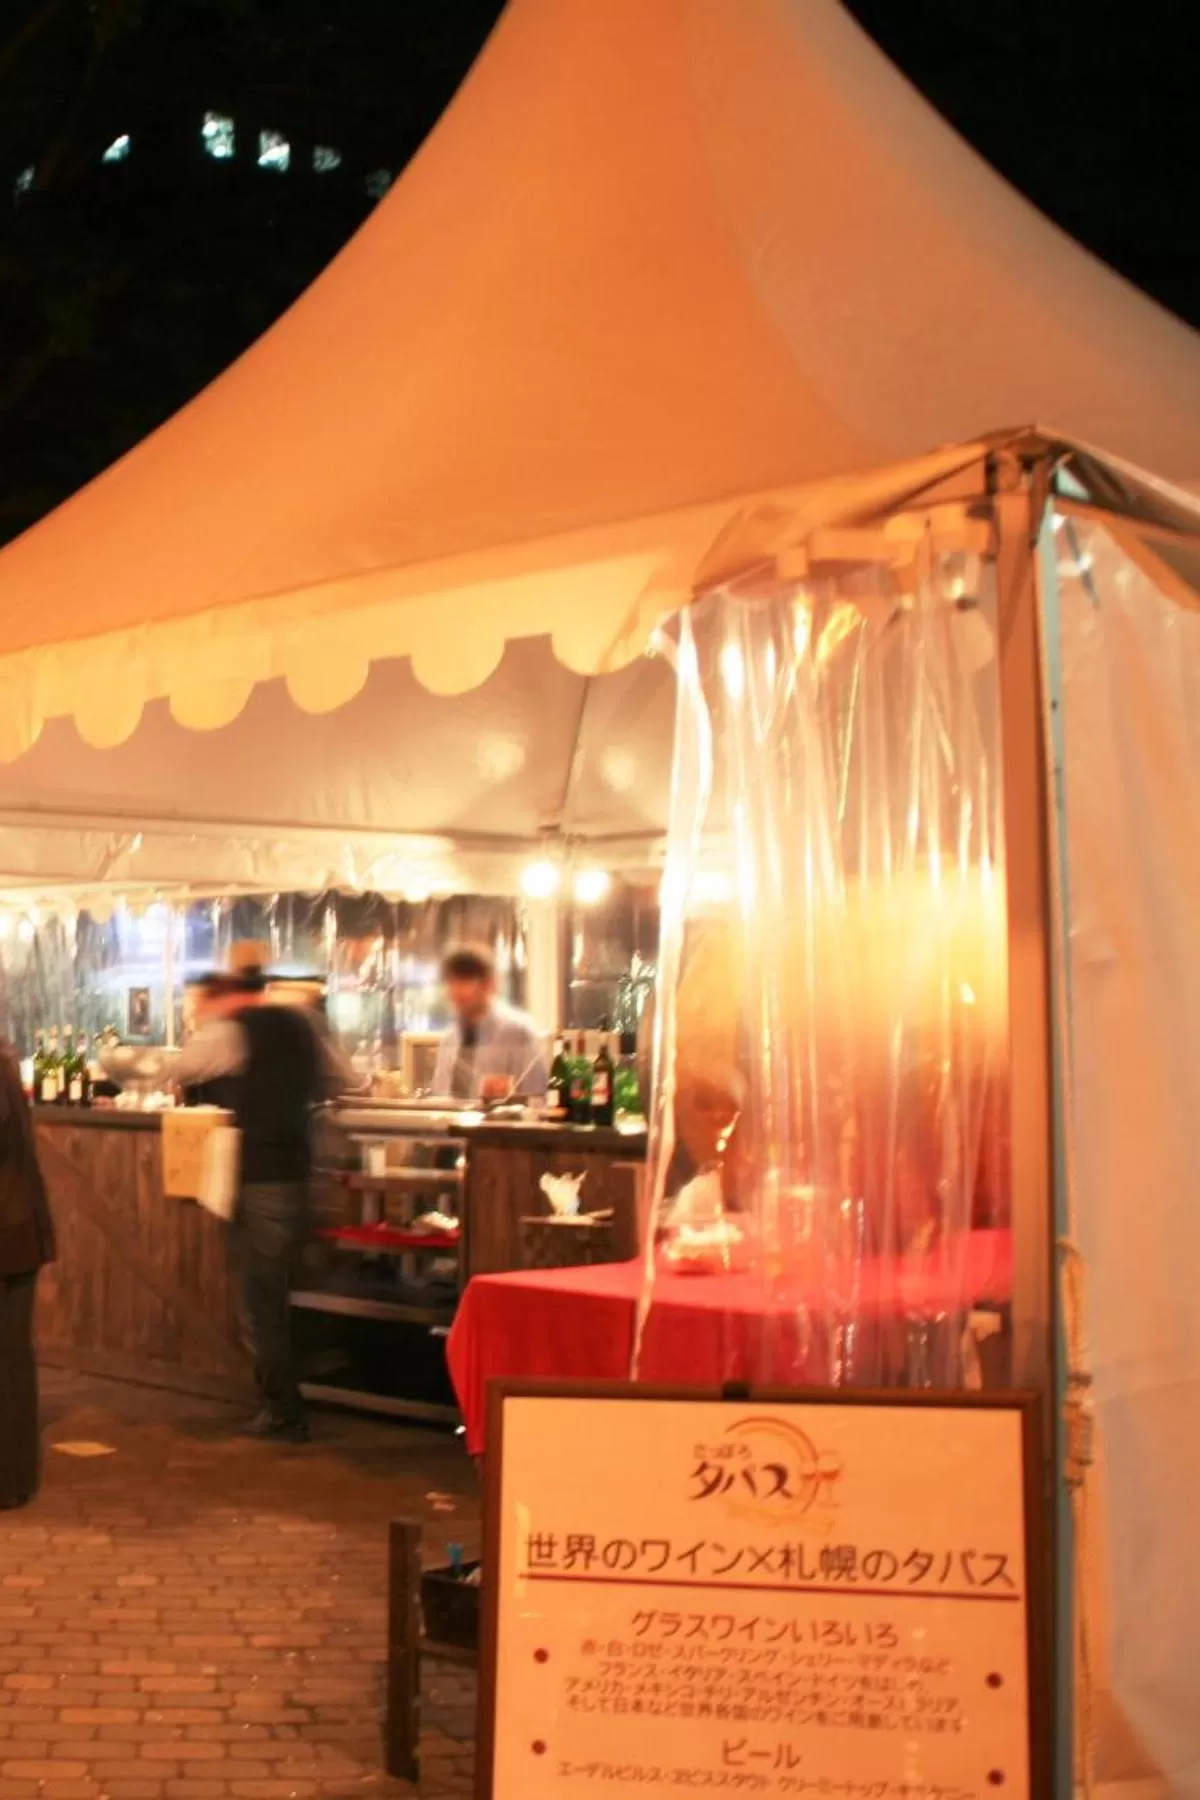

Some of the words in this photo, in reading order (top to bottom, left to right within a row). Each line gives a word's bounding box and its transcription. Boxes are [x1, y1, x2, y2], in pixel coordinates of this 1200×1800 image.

[631, 1610, 900, 1649] グラスワインいろいろ
[721, 1738, 802, 1769] ビール
